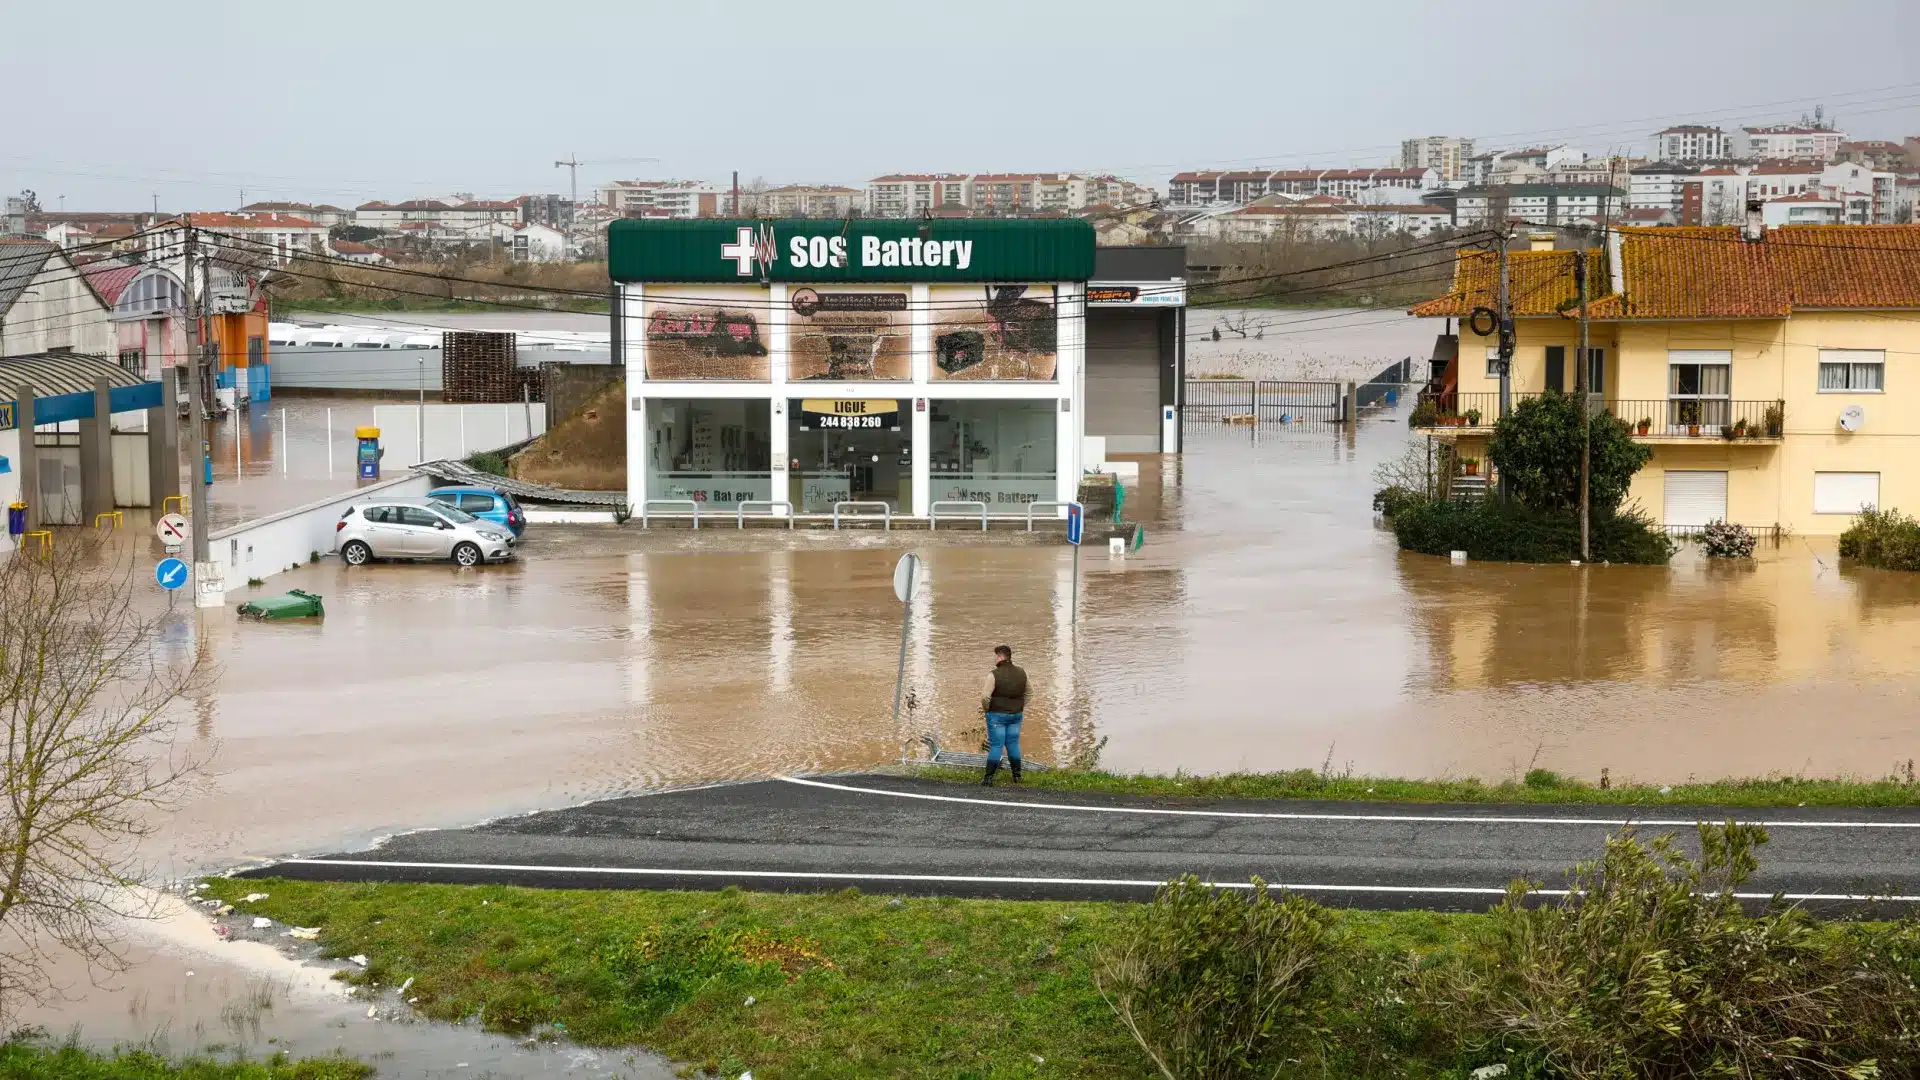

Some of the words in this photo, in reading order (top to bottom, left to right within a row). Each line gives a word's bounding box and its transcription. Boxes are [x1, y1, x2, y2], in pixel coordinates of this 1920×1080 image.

[790, 236, 848, 267] SOS
[861, 235, 972, 269] Battery
[834, 401, 866, 413] LIGUE
[820, 416, 839, 427] 244
[840, 416, 860, 427] 838
[861, 416, 882, 427] 260
[713, 490, 754, 501] Batery
[970, 491, 991, 503] SOS
